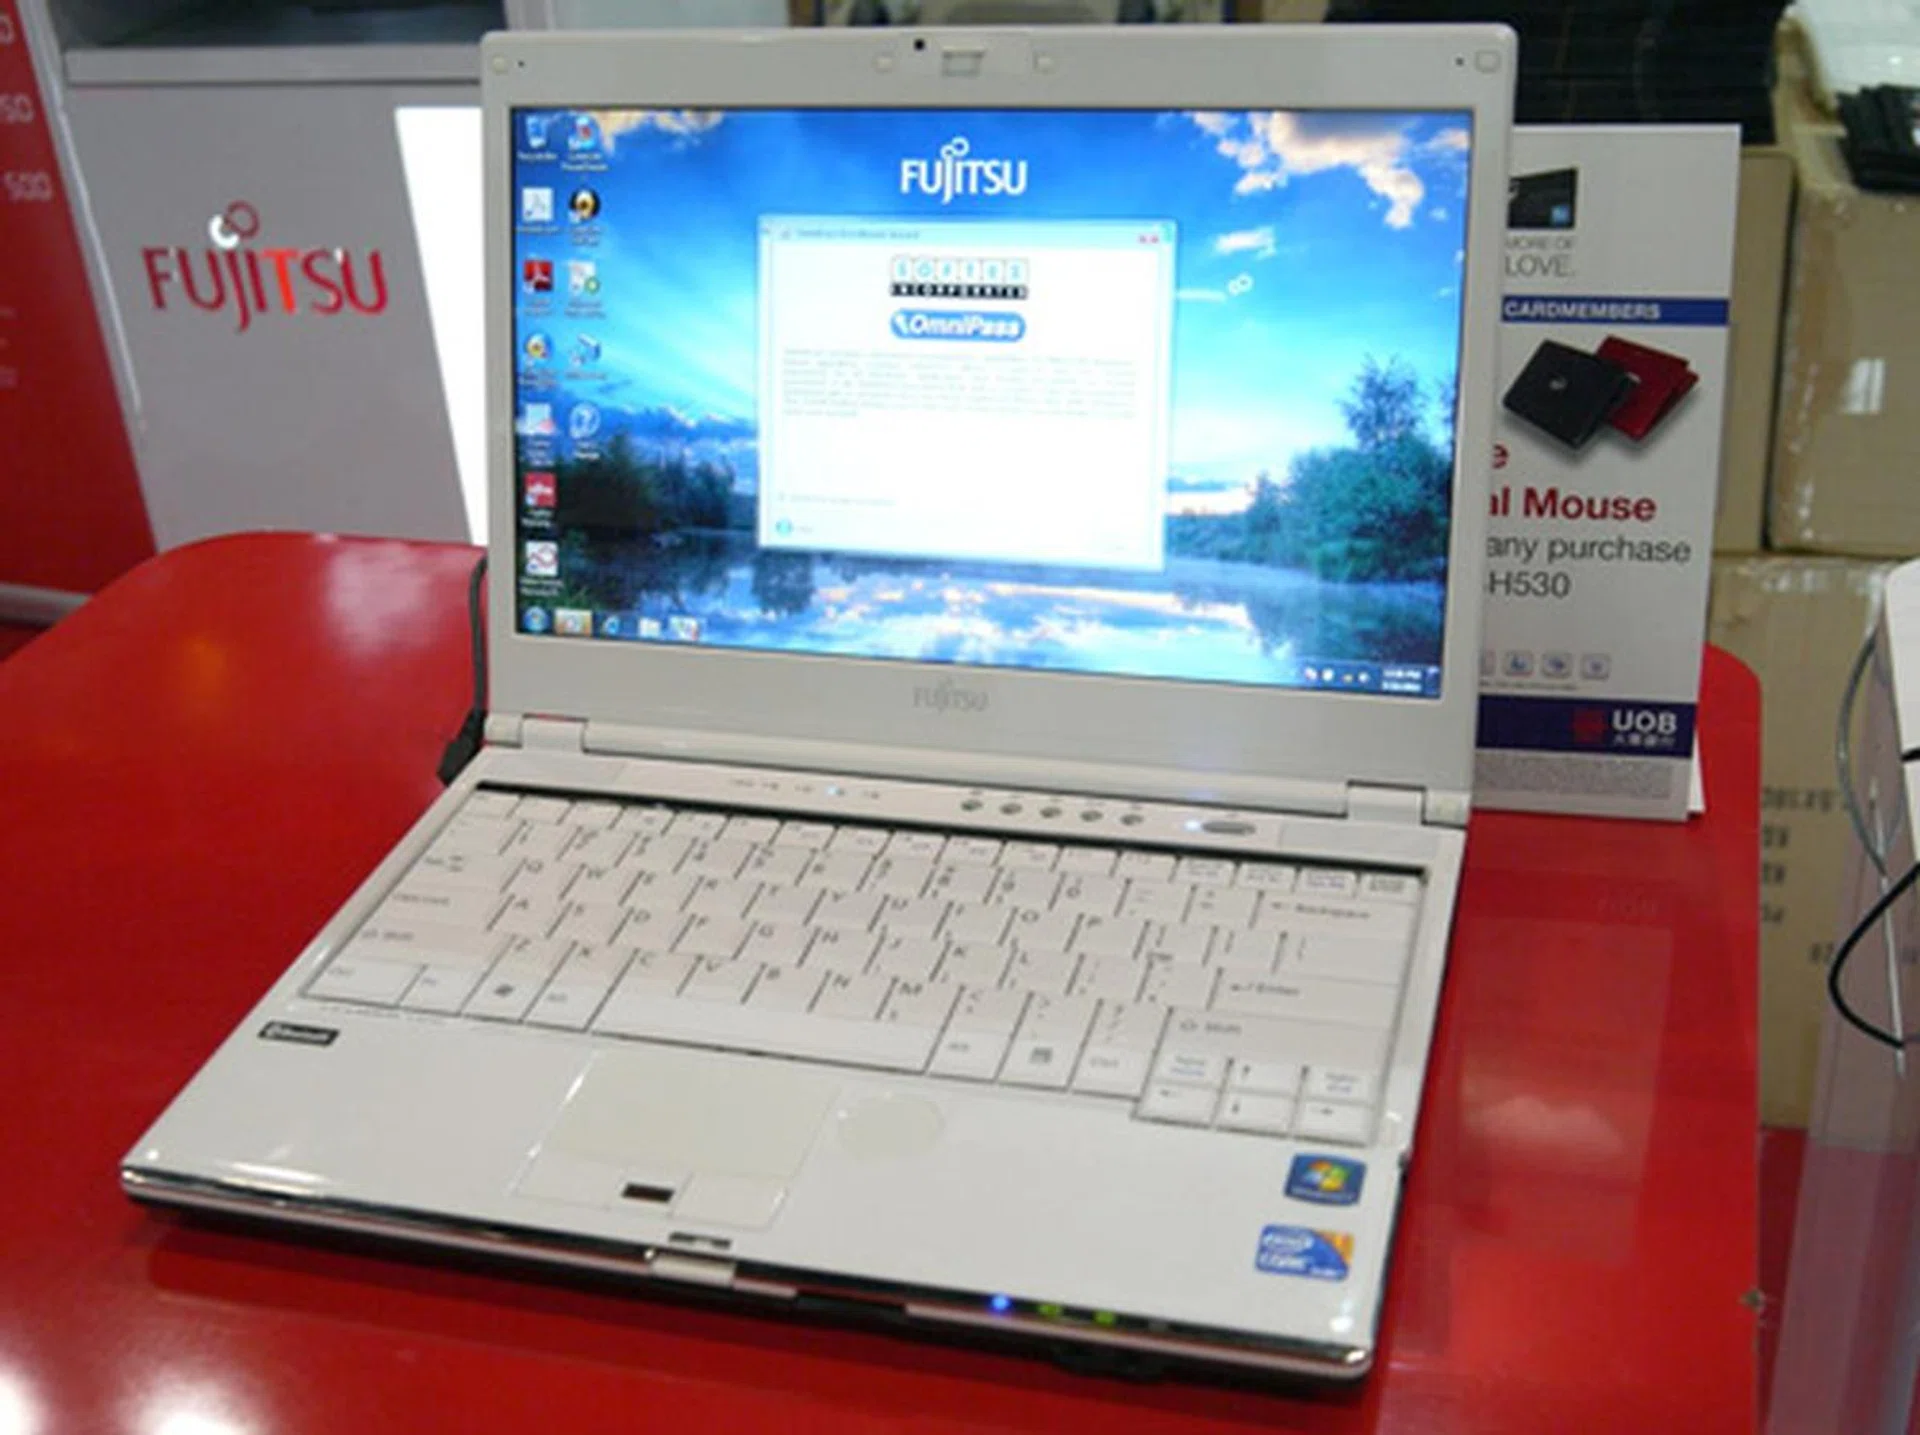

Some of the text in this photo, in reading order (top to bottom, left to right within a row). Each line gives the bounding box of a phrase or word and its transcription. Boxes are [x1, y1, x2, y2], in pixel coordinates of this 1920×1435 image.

[901, 137, 1028, 205] FUJITSU
[140, 201, 390, 333] FUJITSU
[1505, 301, 1661, 320] CARDMEMBERS
[1524, 487, 1657, 522] Mouse
[1487, 535, 1692, 564] any purchase
[1612, 709, 1677, 735] UOB
